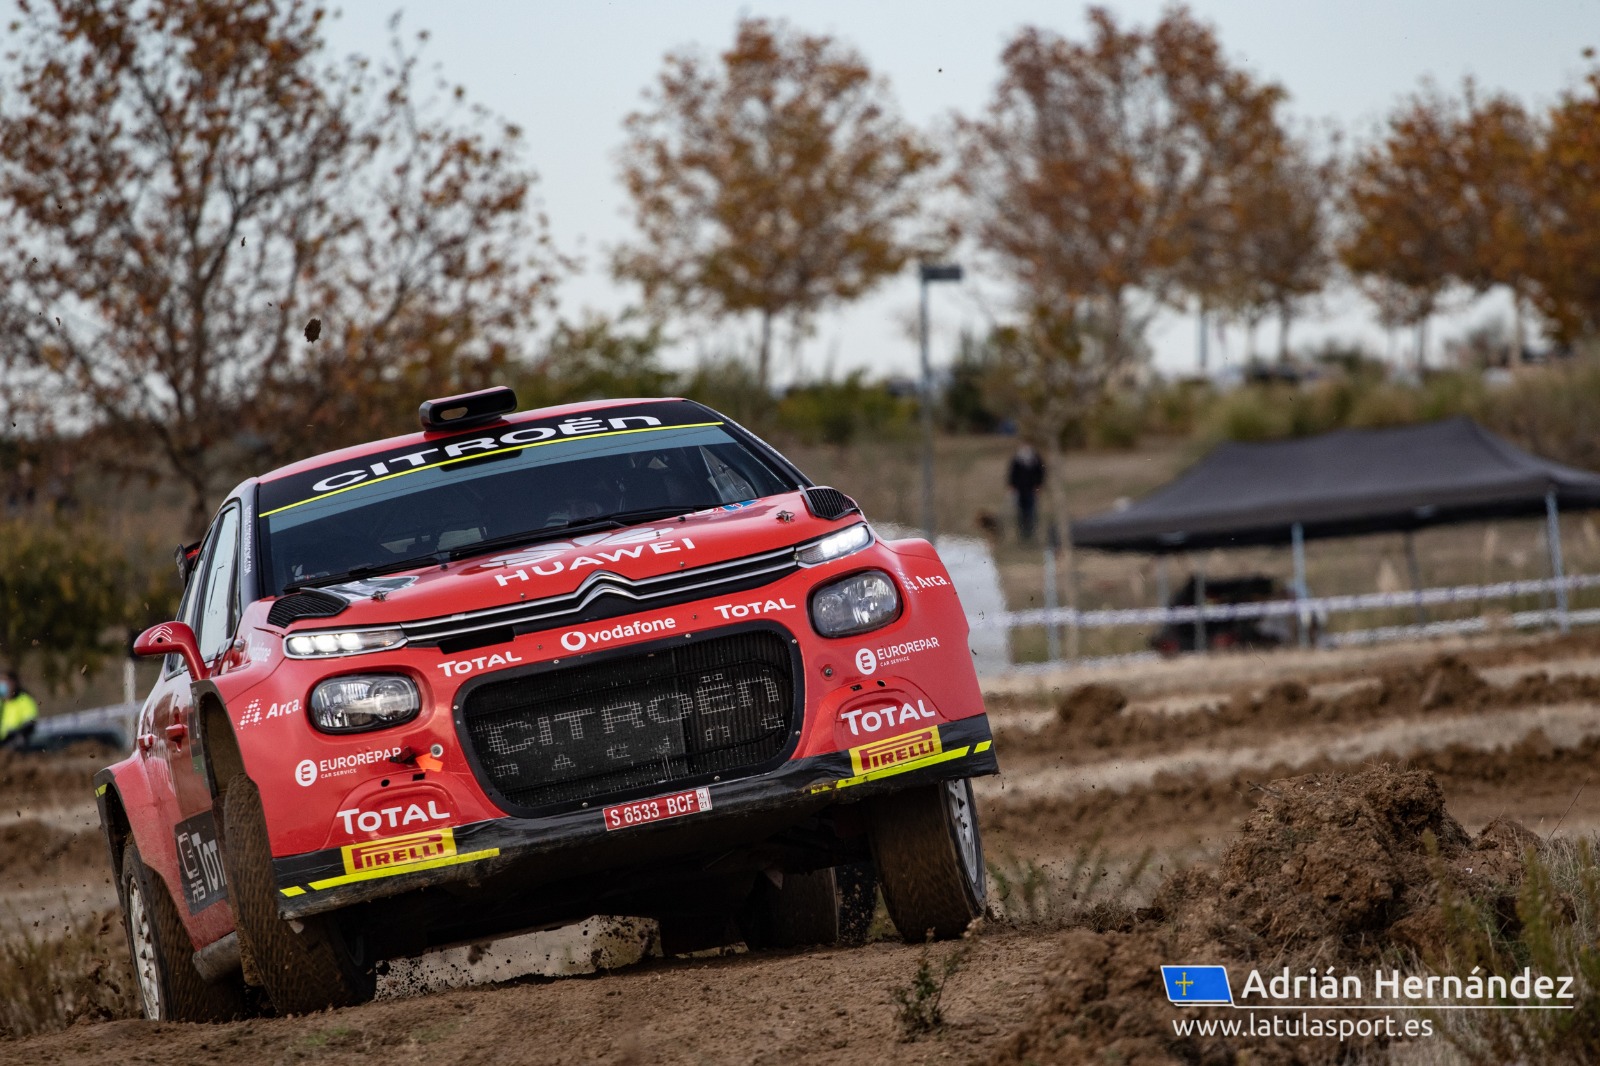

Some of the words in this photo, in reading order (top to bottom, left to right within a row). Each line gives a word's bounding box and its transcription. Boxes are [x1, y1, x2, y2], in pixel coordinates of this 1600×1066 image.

[494, 537, 696, 587] HUAWEI
[713, 598, 796, 620] TOTAL
[588, 617, 676, 644] vodafone
[876, 637, 940, 660] EUROREPAR
[891, 656, 910, 665] SERVICE
[437, 651, 522, 677] TOTAL
[841, 699, 935, 736] TOTAL
[858, 731, 934, 771] PIRELLI
[333, 768, 357, 777] SERVICE
[337, 800, 450, 834] TOTAL
[610, 809, 620, 826] S
[623, 801, 660, 823] 6533
[666, 793, 694, 815] BCF
[351, 834, 444, 870] PIRELLI
